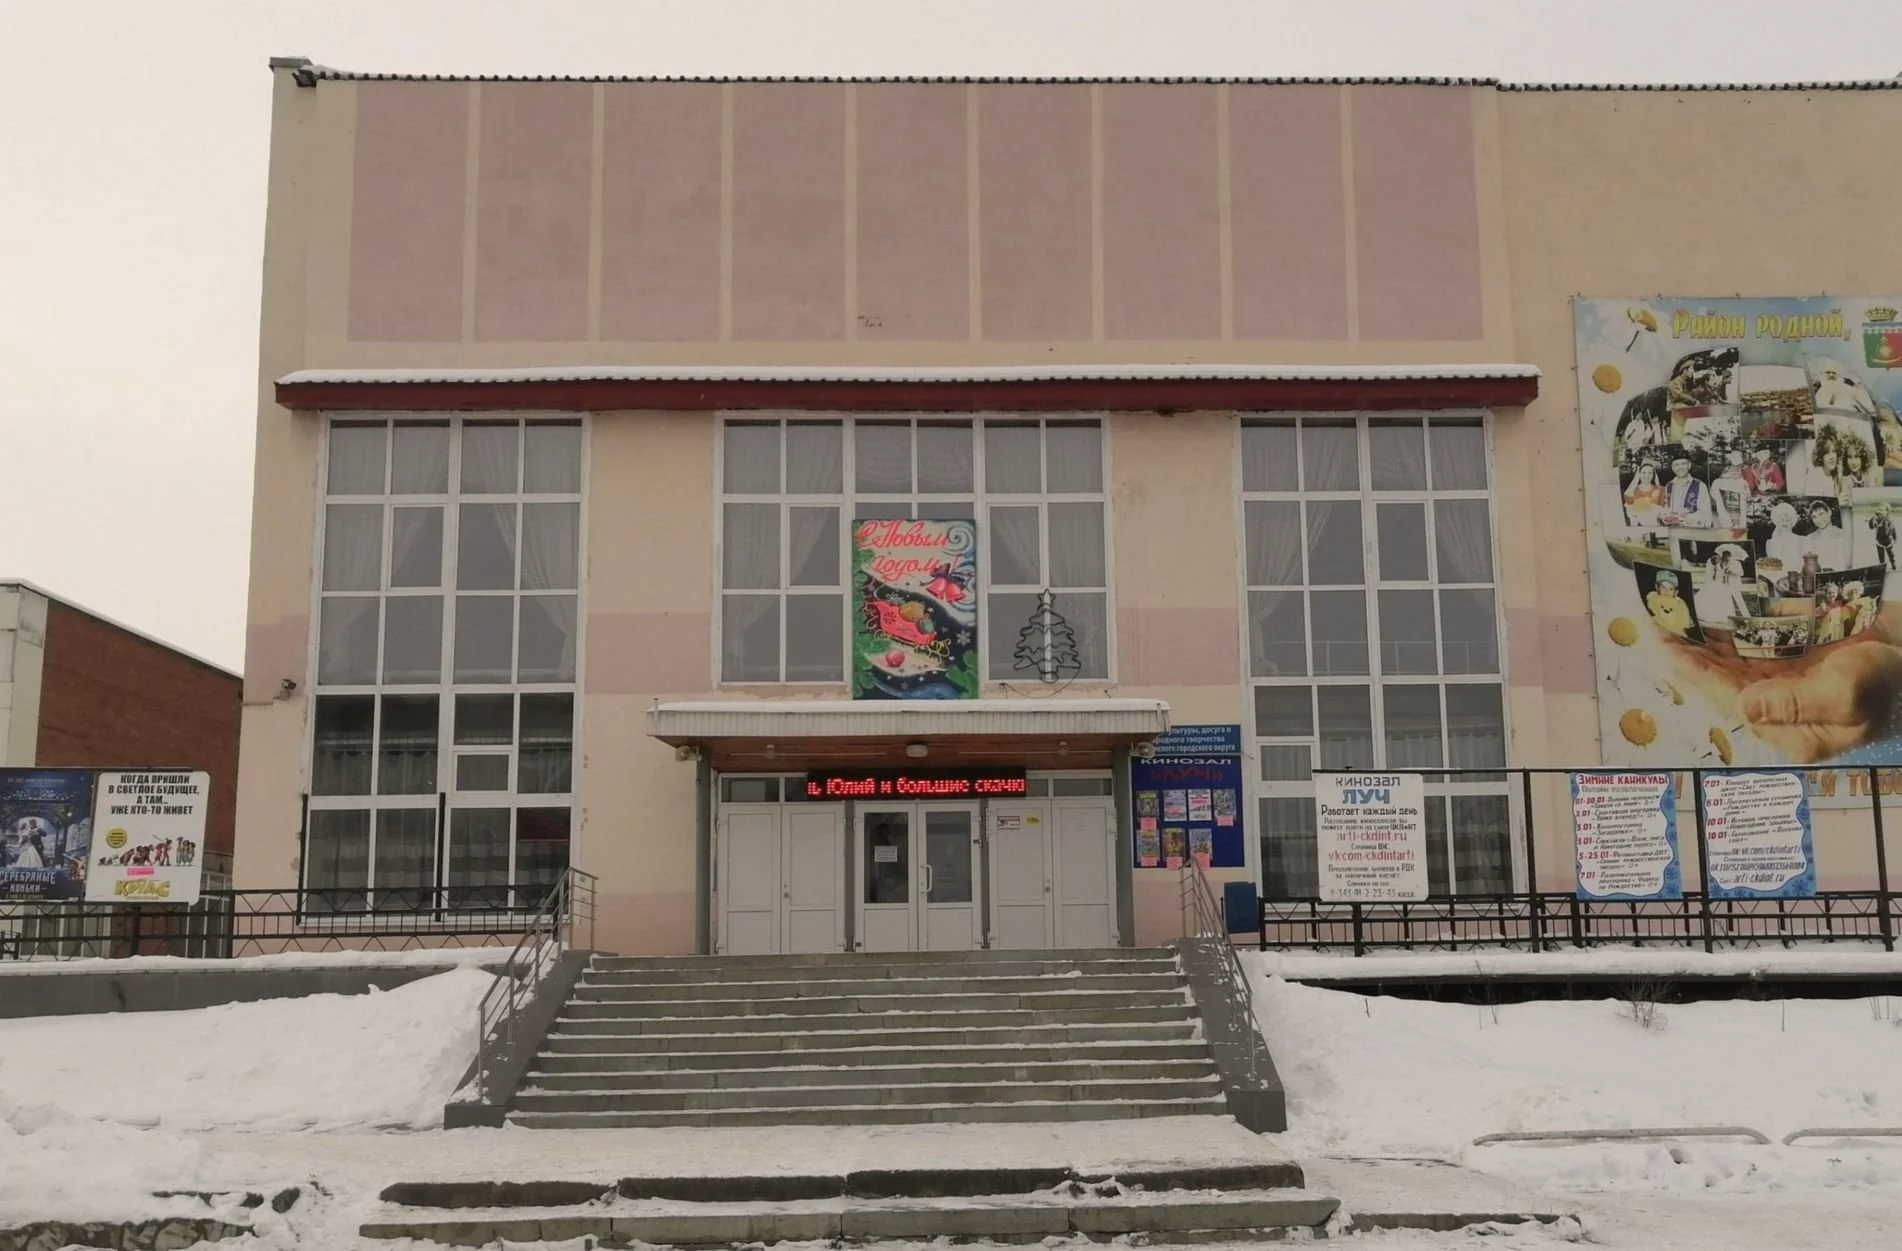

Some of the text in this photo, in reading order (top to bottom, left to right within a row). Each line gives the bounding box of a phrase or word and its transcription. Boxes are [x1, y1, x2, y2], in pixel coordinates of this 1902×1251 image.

[871, 520, 949, 549] Новым
[1186, 736, 1225, 744] творчества
[120, 774, 190, 785] КОГДА ПРИШЛИ
[108, 785, 200, 796] В СВЕТЛОЕ БУДУЩЕЕ,
[826, 778, 876, 795] Юлий
[880, 780, 892, 793] и
[136, 795, 143, 804] А
[1342, 788, 1390, 805] ЛУЧ
[111, 805, 193, 815] УЖЕ КТО-ТО ЖИВЕТ
[1321, 804, 1418, 816] Работает каждый день
[0, 870, 56, 885] СЕРЕБРЯНЫЕ
[10, 883, 41, 893] КОНЬКИ
